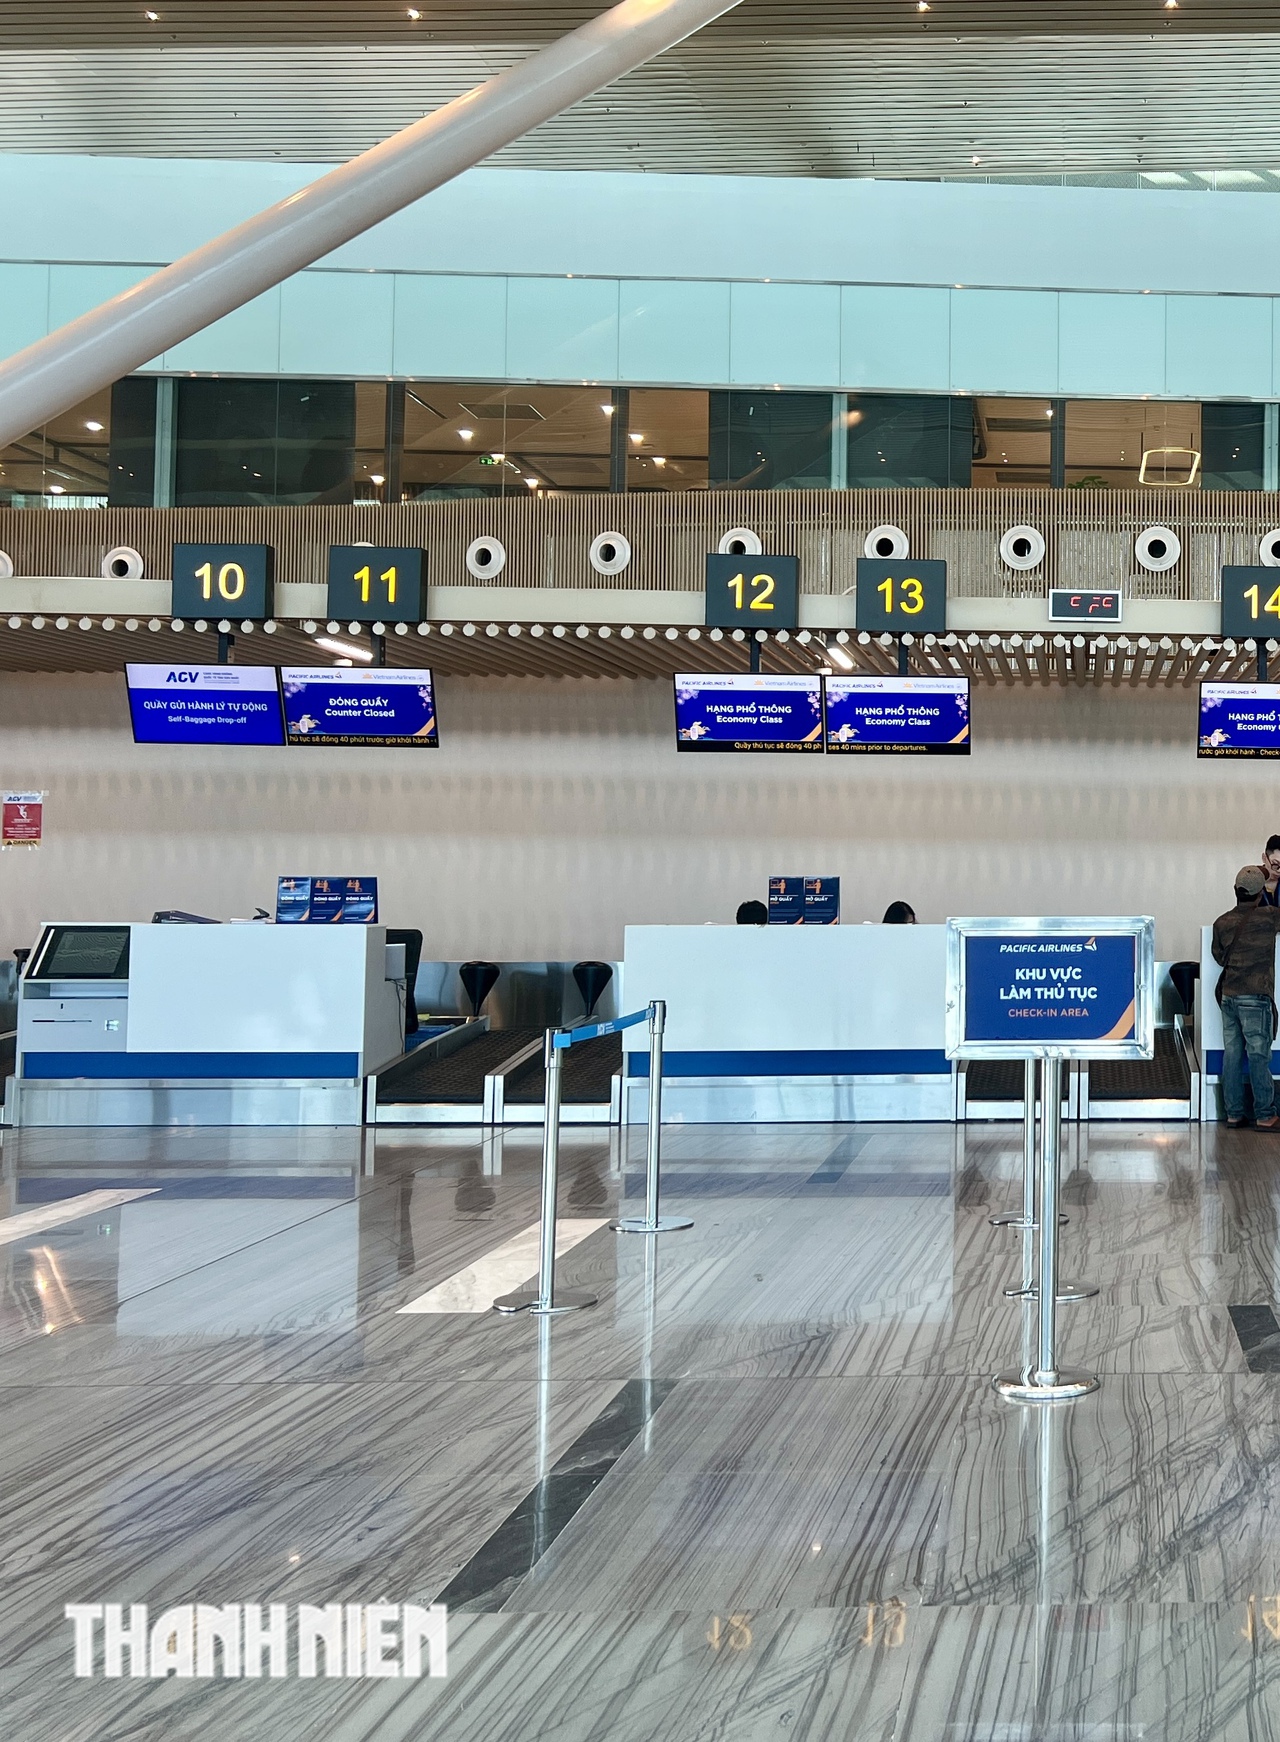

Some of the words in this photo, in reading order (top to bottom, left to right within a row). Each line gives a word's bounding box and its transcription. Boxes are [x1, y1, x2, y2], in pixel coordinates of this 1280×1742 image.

[194, 562, 245, 600] 10
[353, 566, 396, 602] 11
[728, 573, 776, 610] 12
[877, 577, 924, 614] 13
[166, 672, 199, 682] ACV
[188, 700, 214, 710] HÀNH
[242, 702, 268, 712] ĐỘNG
[329, 696, 358, 706] ĐÓNG
[364, 709, 395, 717] Closed
[706, 705, 734, 714] HẠNG
[736, 702, 756, 713] PHỔ
[758, 704, 792, 713] THÔNG
[855, 708, 883, 716] HẠNG
[885, 704, 904, 715] PHỔ
[906, 707, 940, 715] THÔNG
[168, 716, 216, 724] Self-Baggage
[716, 715, 757, 724] Economy
[865, 718, 906, 726] Economy
[1228, 713, 1254, 722] HẠNG
[1257, 710, 1276, 721] PHỔ
[1237, 723, 1276, 732] Economy
[1000, 944, 1037, 953] PACIFIC
[1038, 944, 1082, 952] AIRLINES
[1015, 968, 1046, 980] KHU
[1050, 966, 1082, 983] VỰC
[1000, 985, 1030, 1000] LÀM
[1034, 983, 1064, 999] THỦ
[1068, 987, 1097, 1002] TỤC
[1008, 1008, 1058, 1018] CHECK-IN
[1060, 1008, 1089, 1017] AREA
